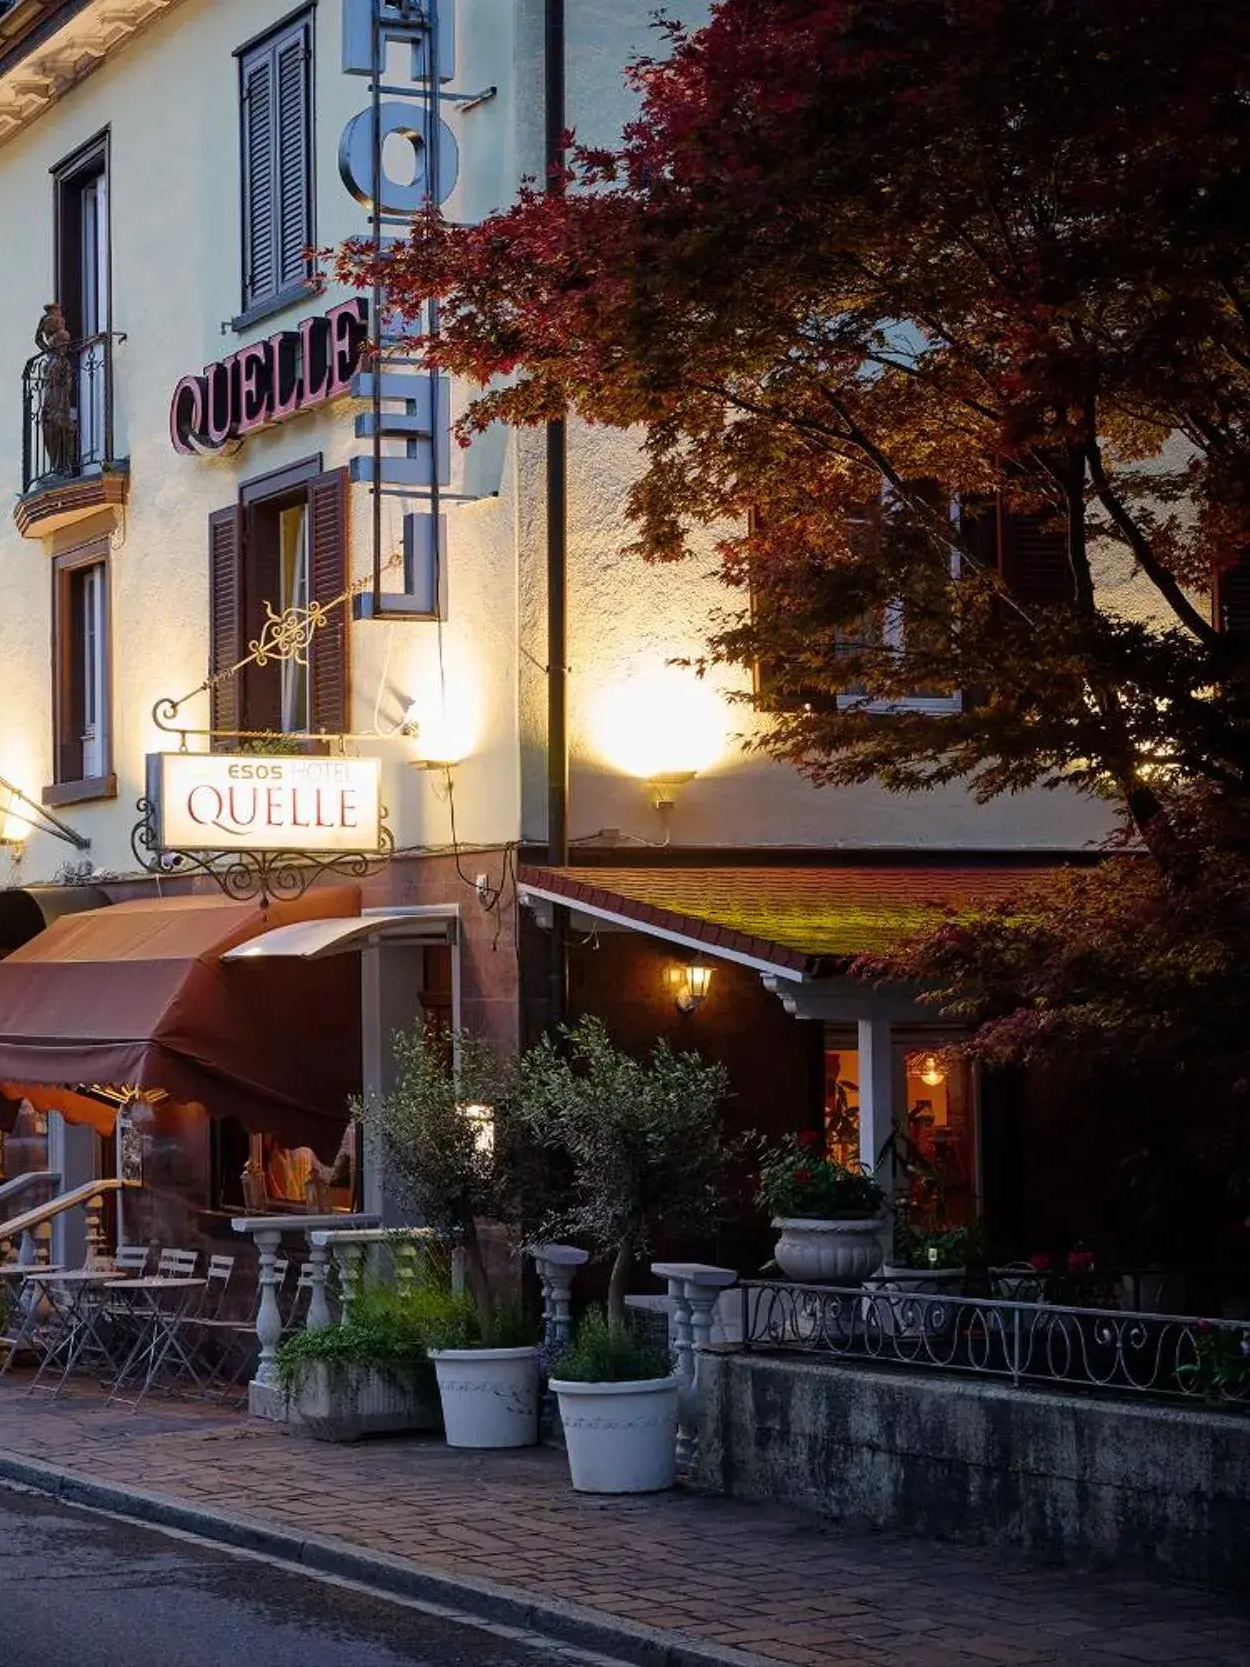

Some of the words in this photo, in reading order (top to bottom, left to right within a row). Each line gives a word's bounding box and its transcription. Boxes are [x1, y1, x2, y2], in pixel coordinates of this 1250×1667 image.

[170, 297, 369, 457] QUELLE
[228, 764, 283, 780] ESOS
[187, 784, 358, 836] QUELLE
